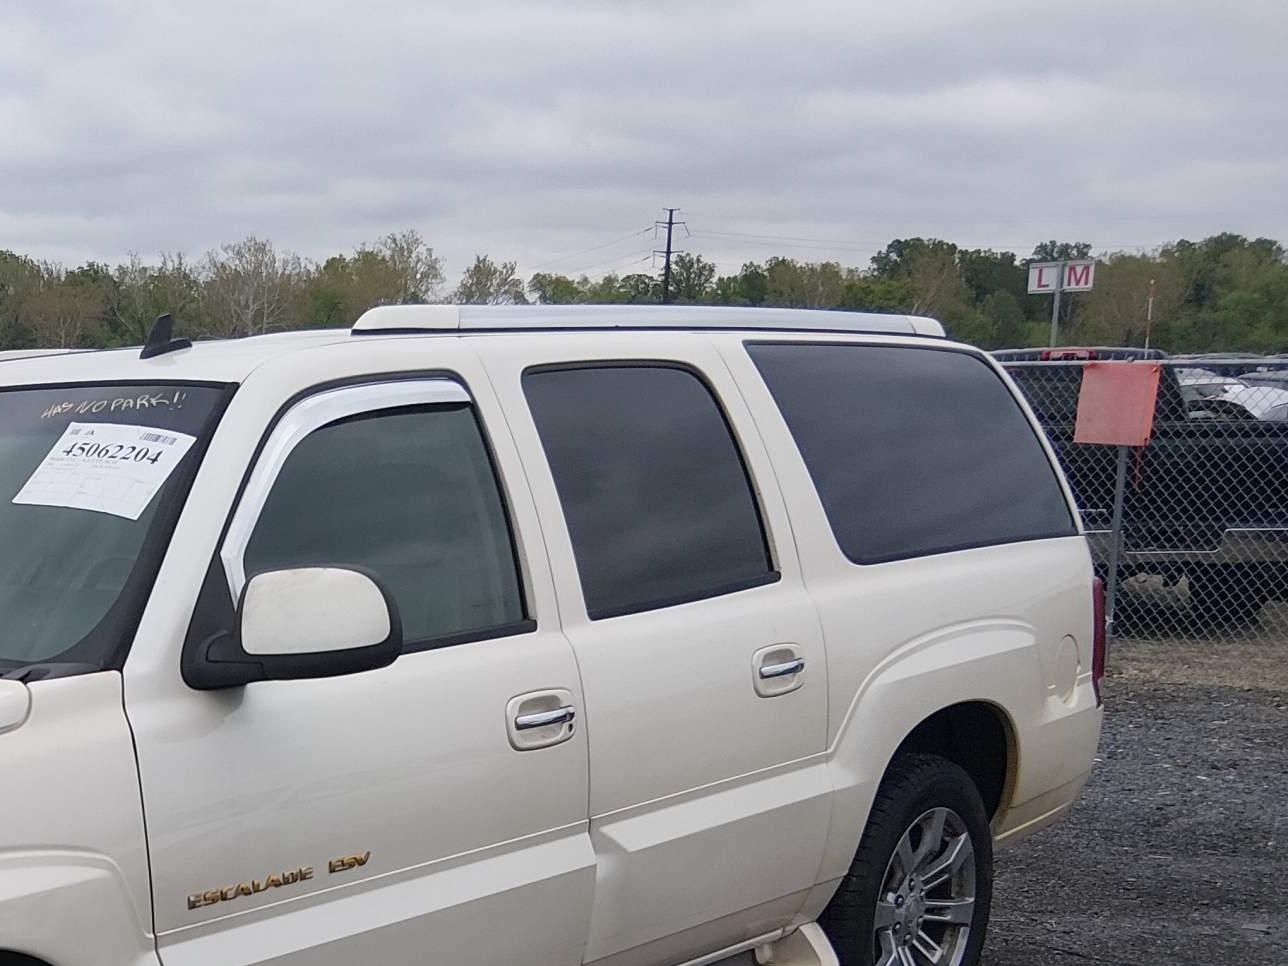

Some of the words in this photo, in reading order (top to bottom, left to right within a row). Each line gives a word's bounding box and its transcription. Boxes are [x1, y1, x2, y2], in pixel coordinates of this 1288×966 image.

[1035, 266, 1050, 289] L
[1066, 264, 1091, 287] M
[76, 400, 105, 415] NO
[62, 440, 164, 465] 45062204
[187, 866, 314, 910] ESCALADE
[328, 850, 371, 874] ESV
